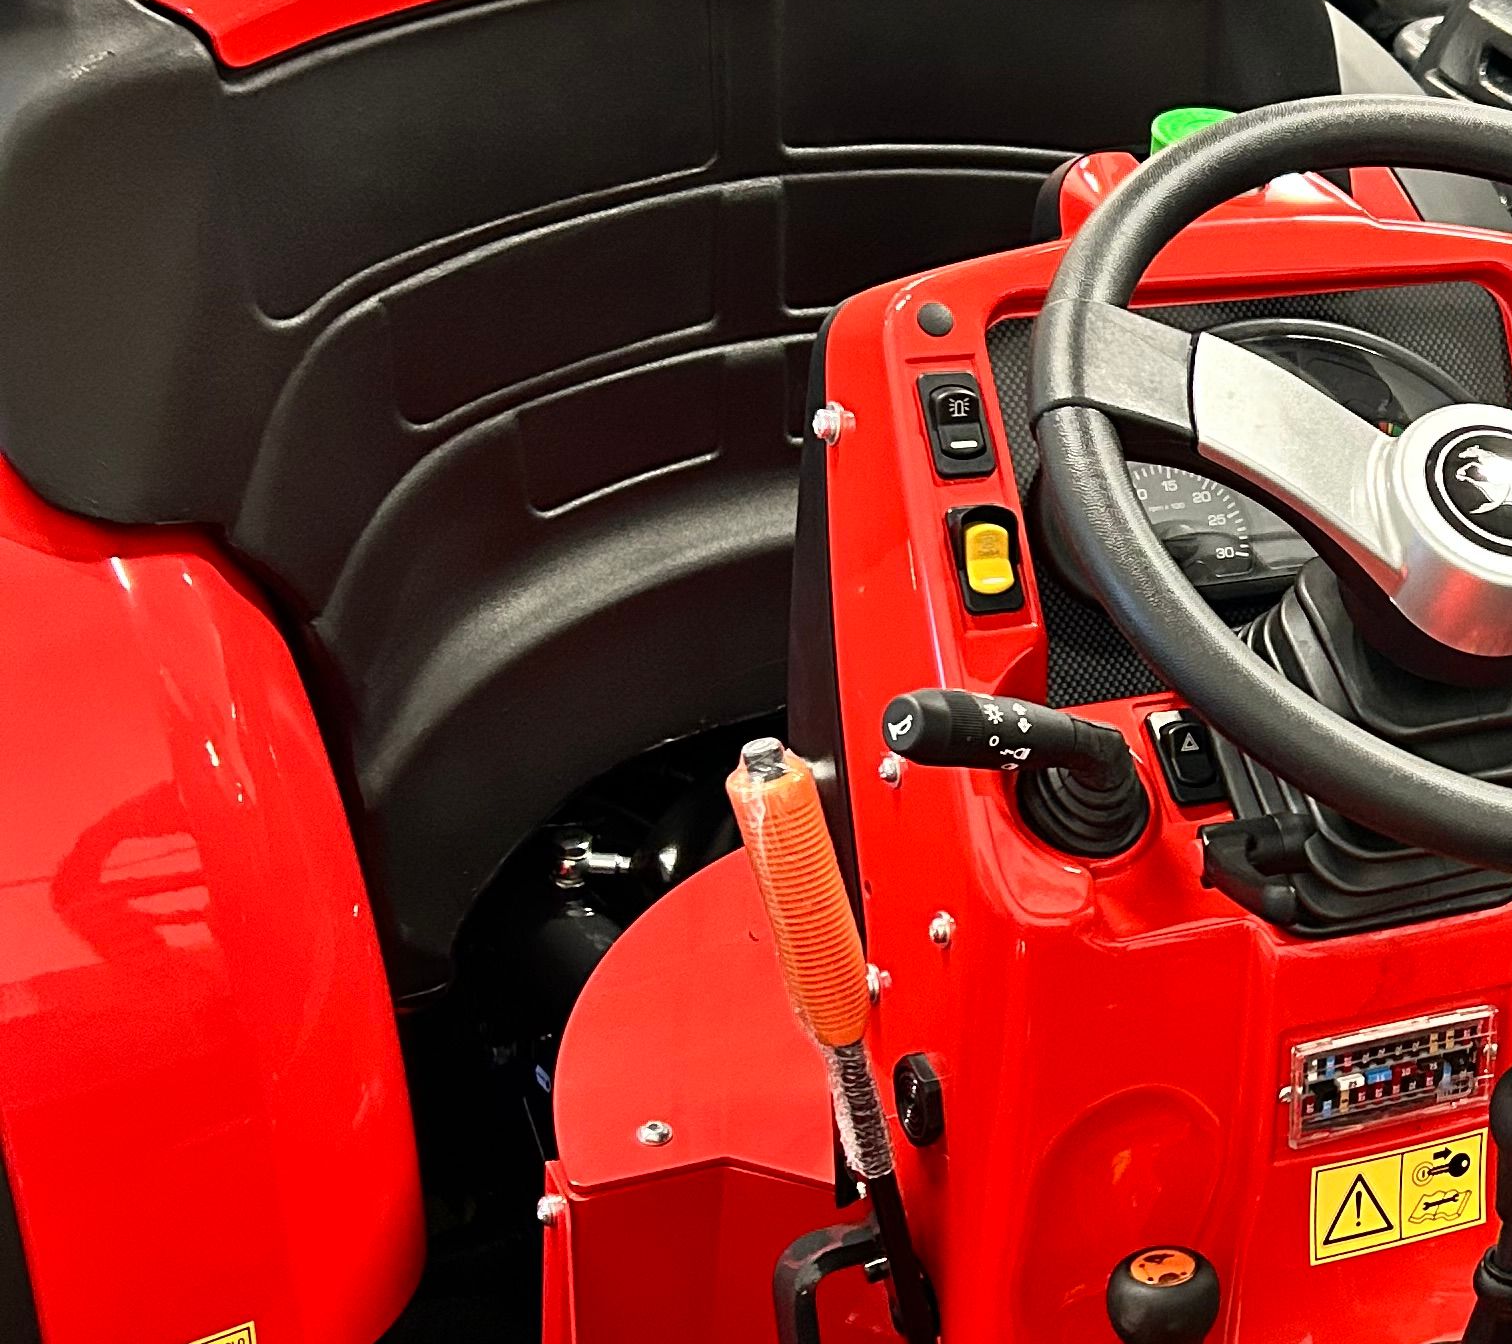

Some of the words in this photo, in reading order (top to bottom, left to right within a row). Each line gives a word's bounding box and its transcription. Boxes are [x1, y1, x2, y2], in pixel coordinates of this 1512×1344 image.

[1161, 480, 1178, 492] 15
[1192, 490, 1212, 504] 20
[1208, 514, 1227, 526] 25
[1215, 547, 1235, 559] 30
